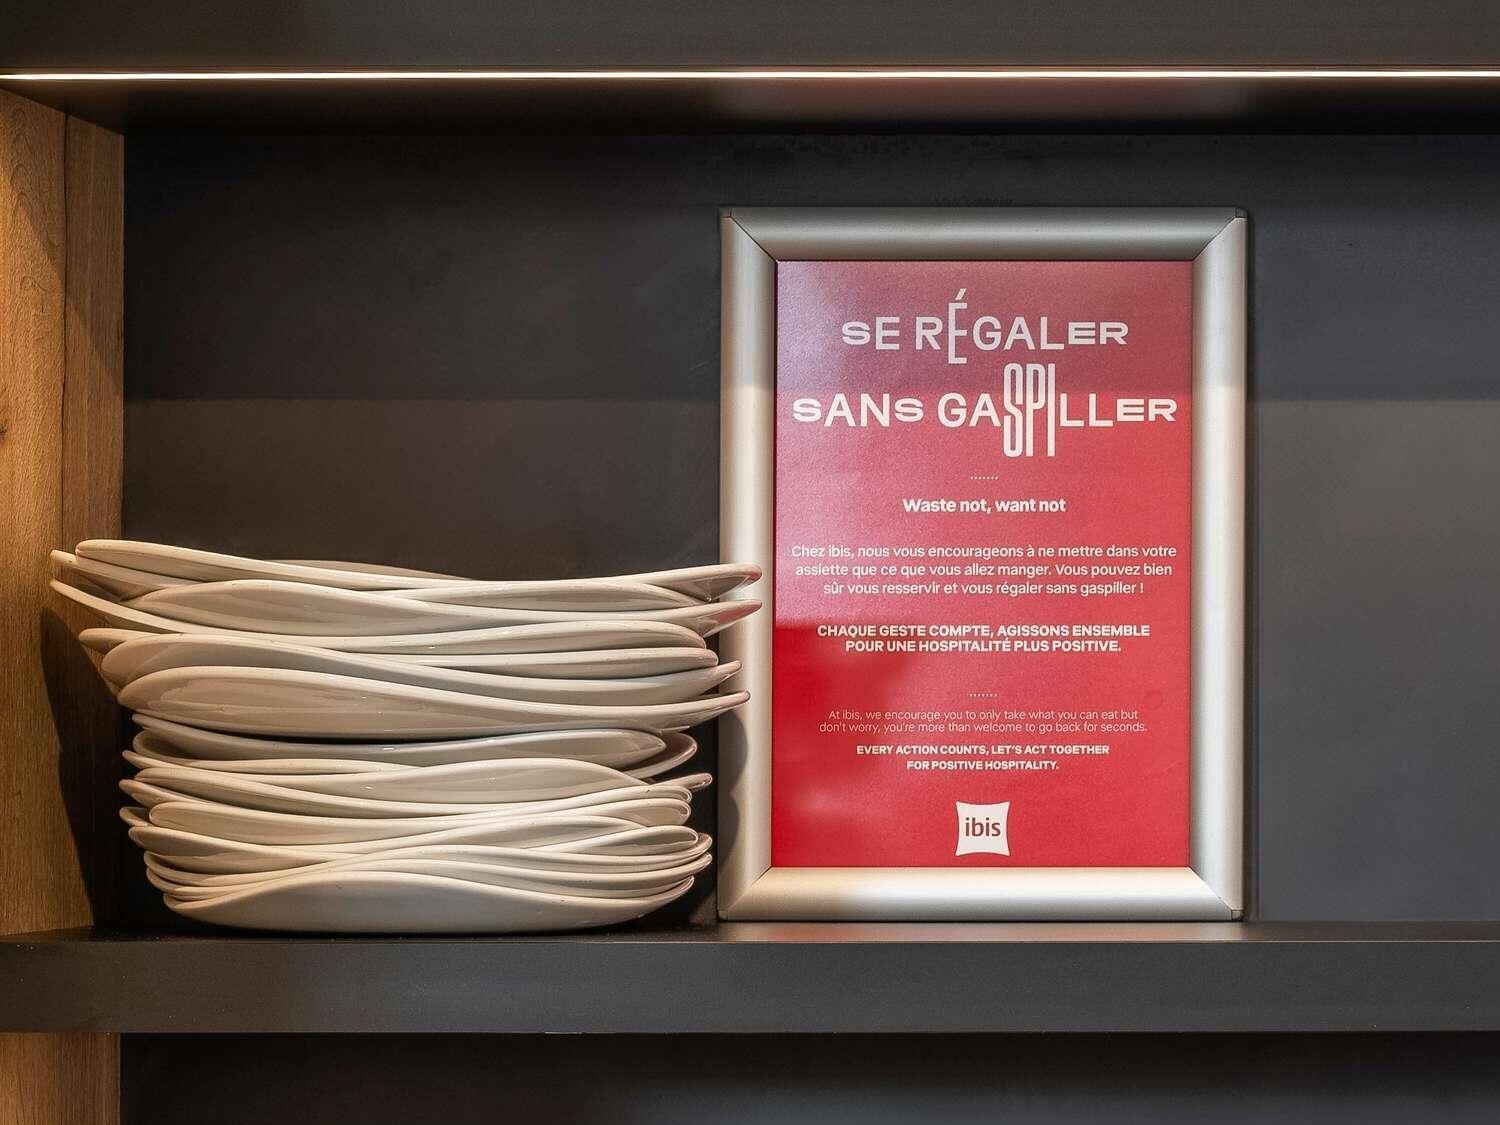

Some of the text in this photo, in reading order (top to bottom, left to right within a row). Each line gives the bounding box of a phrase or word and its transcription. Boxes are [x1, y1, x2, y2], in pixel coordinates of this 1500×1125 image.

[842, 289, 1129, 364] SE RÉGALER
[792, 362, 1178, 457] SANS GASPILLER
[903, 498, 1066, 515] Waste not, want not
[792, 544, 1176, 561] Chez ibis, nous vous encourageons à ne mettre dans votre
[796, 562, 1172, 579] assiette que ce que vous allez manger. Vous pouvez bien
[824, 581, 843, 594] sûr
[848, 584, 878, 594] vous
[883, 581, 940, 594] resservir
[944, 582, 958, 595] et
[961, 583, 993, 595] vous
[997, 581, 1043, 598] régaler
[1047, 583, 1077, 594] sans
[1081, 581, 1136, 597] gaspiller
[818, 624, 1150, 638] CHAQUE GESTE COMPTE, AGISSONS ENSEMBLE
[846, 636, 1121, 652] POUR UNE HOSPITALITÉ PLUS POSITIVE.
[829, 711, 840, 720] At
[843, 710, 862, 722] ibis,
[885, 712, 941, 722] encourage
[944, 712, 962, 722] you
[966, 711, 976, 720] to
[980, 710, 1001, 721] only
[1004, 710, 1025, 719] take
[1029, 710, 1054, 719] what
[1058, 712, 1076, 721] you
[1080, 712, 1098, 720] can
[1102, 711, 1118, 720] eat
[1121, 710, 1137, 720] but
[820, 721, 1147, 735] don't worry, you're more than welcome to go back for seconds.
[857, 744, 1109, 756] EVERY ACTION COUNTS, LET'S ACT TOGETHER
[907, 760, 1059, 771] FOR POSITIVE HOSPITALITY.
[964, 817, 1001, 837] ibis
